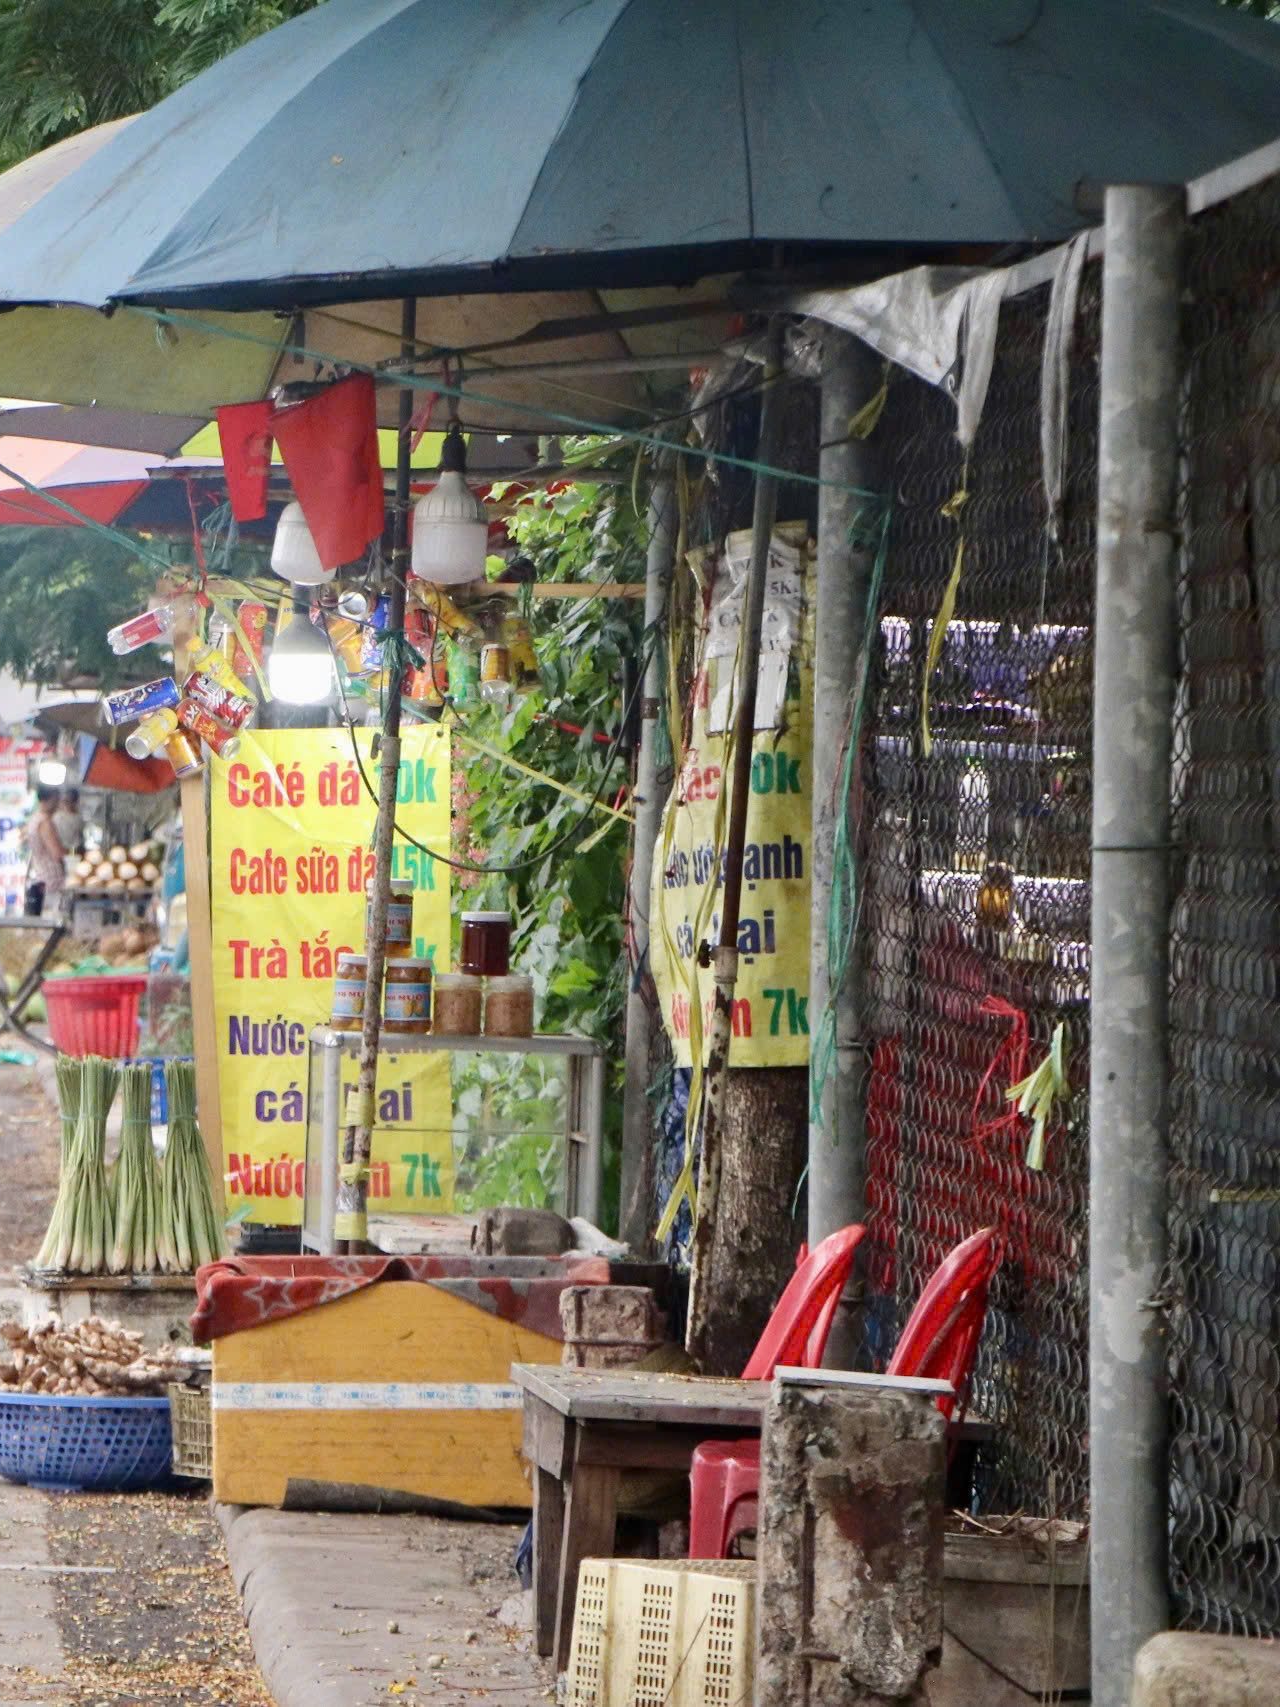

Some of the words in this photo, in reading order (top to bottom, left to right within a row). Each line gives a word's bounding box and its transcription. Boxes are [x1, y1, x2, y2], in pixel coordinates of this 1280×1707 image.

[228, 762, 305, 808] Café
[318, 760, 360, 807] đá
[751, 751, 802, 795] 0k
[230, 847, 288, 895] Cafe
[296, 846, 339, 894] sữa
[744, 834, 803, 891] ạnh
[228, 938, 288, 979] Trà
[676, 914, 694, 959] cá
[763, 987, 810, 1037] 7k
[228, 1014, 305, 1056] Nước
[255, 1081, 320, 1123] cá
[401, 1152, 442, 1198] 7k
